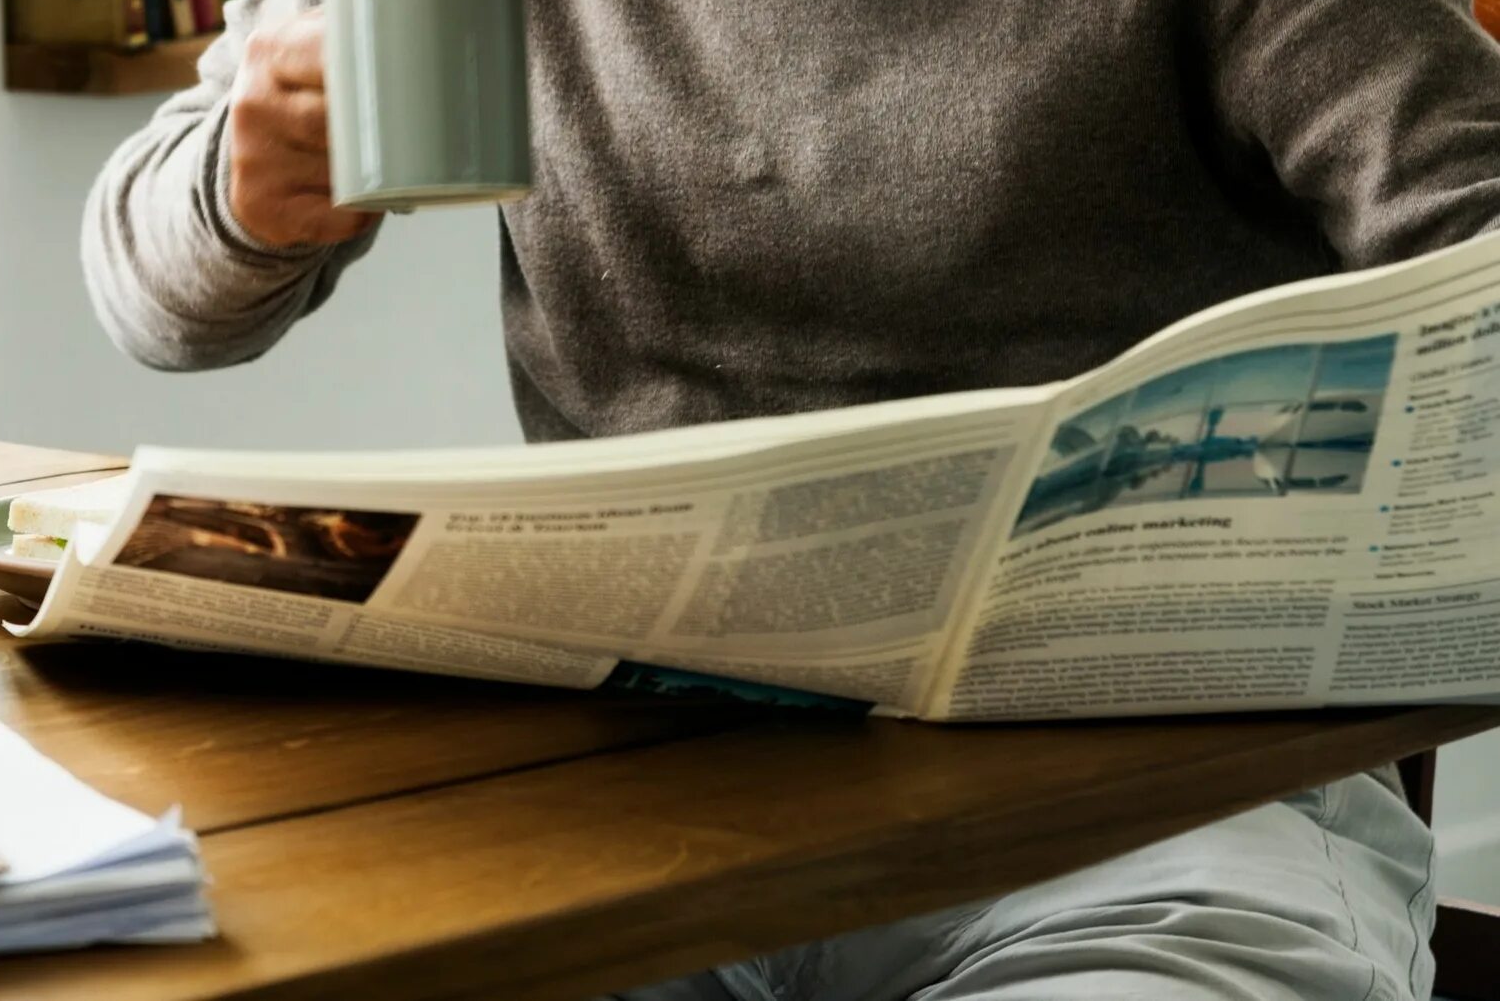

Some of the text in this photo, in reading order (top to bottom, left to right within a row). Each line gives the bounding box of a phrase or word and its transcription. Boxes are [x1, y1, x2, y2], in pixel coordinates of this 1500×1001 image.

[1085, 522, 1136, 538] online
[1142, 516, 1232, 532] marketing
[1389, 596, 1432, 608] Market
